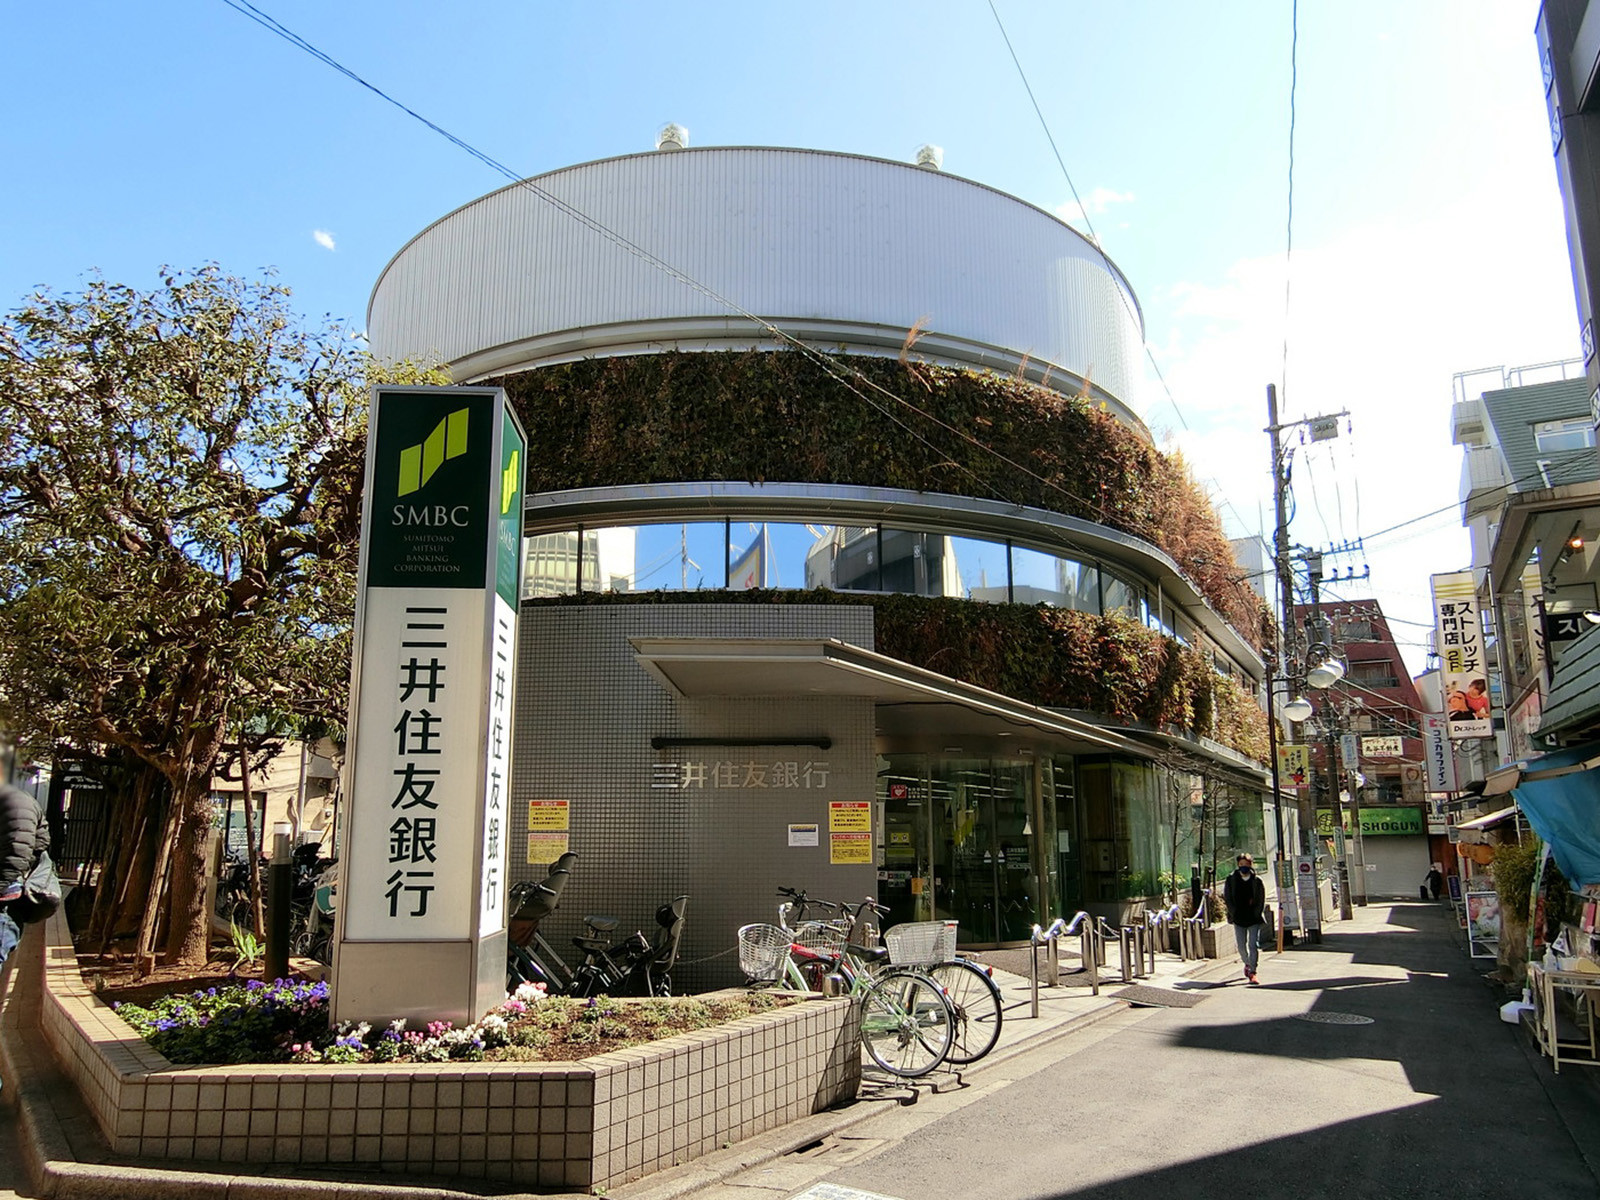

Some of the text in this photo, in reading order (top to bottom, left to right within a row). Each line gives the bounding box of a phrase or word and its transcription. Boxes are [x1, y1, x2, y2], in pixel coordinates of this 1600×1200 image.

[392, 505, 469, 527] SMBC
[403, 535, 455, 543] SUMITOMO
[412, 544, 444, 552] MITSUI
[500, 520, 516, 557] SMBC
[393, 564, 461, 573] CORPORATION
[406, 554, 449, 562] BANKING
[1440, 603, 1460, 646] 専門店
[1457, 602, 1480, 673] ストレッチ
[1447, 650, 1460, 672] 2F
[384, 607, 447, 918] 三井住友銀行
[486, 619, 509, 912] 三井住友銀行
[1433, 729, 1447, 786] ココカラファイン
[650, 760, 831, 789] 三井住友銀行
[1361, 821, 1420, 833] SHOGUN
